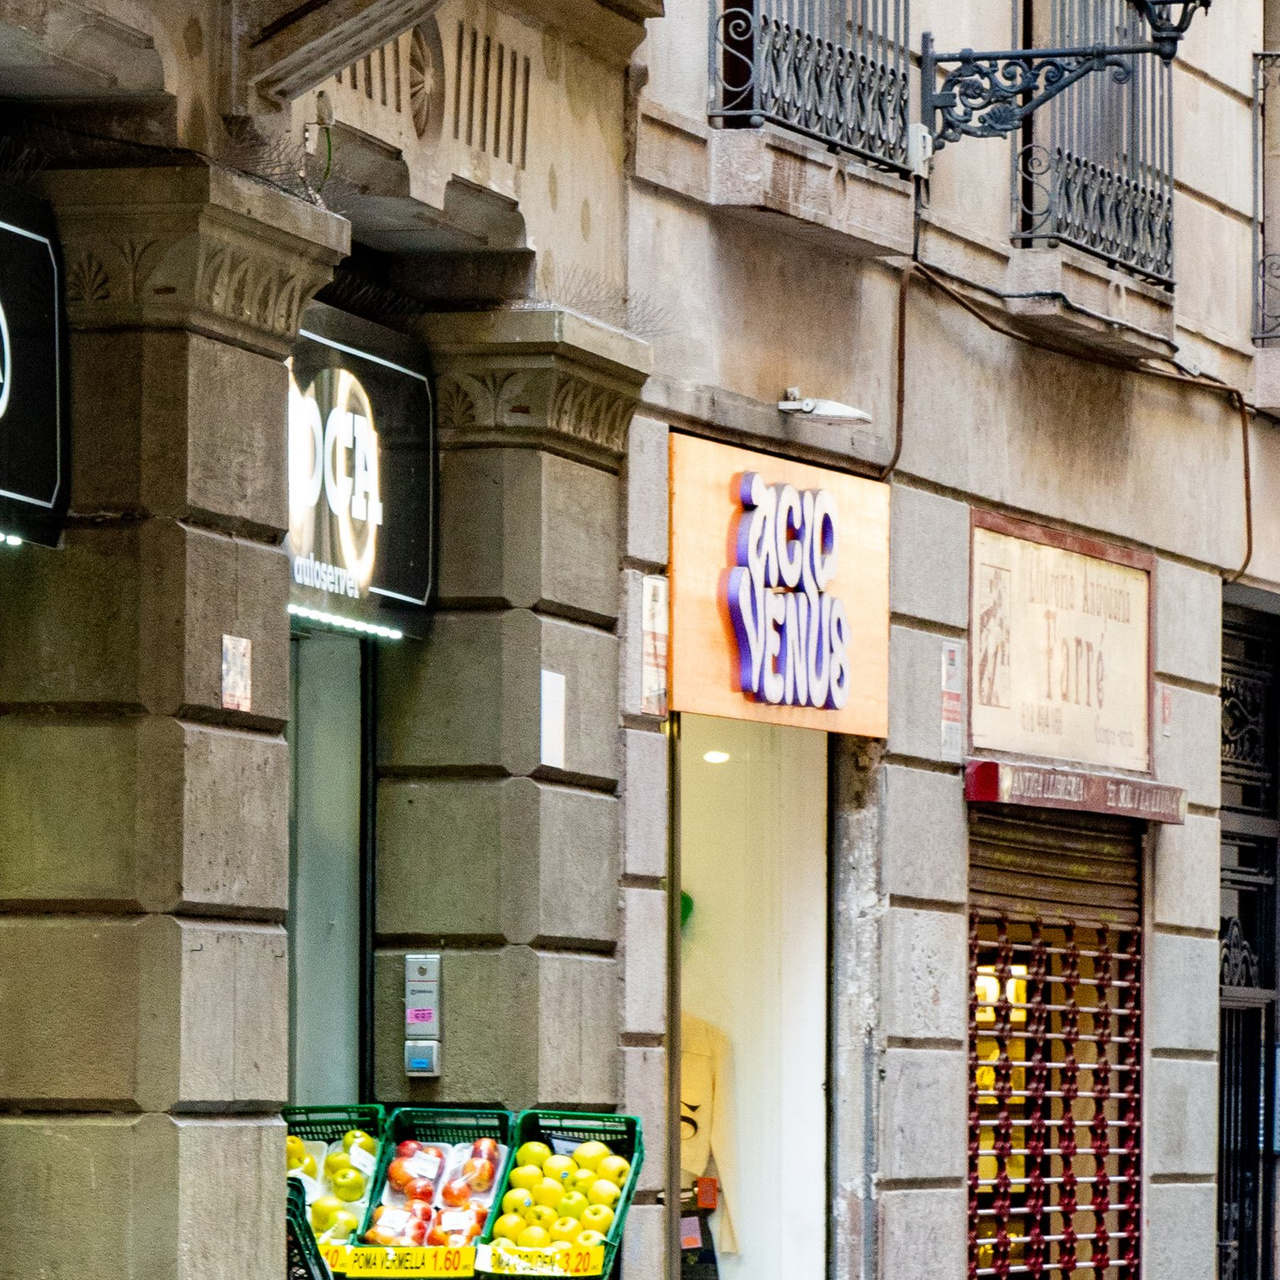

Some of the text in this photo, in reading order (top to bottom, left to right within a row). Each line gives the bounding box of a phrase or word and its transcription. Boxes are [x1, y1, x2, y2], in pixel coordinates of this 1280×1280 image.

[732, 566, 851, 707] VENUS
[1043, 609, 1105, 710] Farré
[353, 1252, 377, 1270] POMA
[432, 1249, 461, 1271] 1.60
